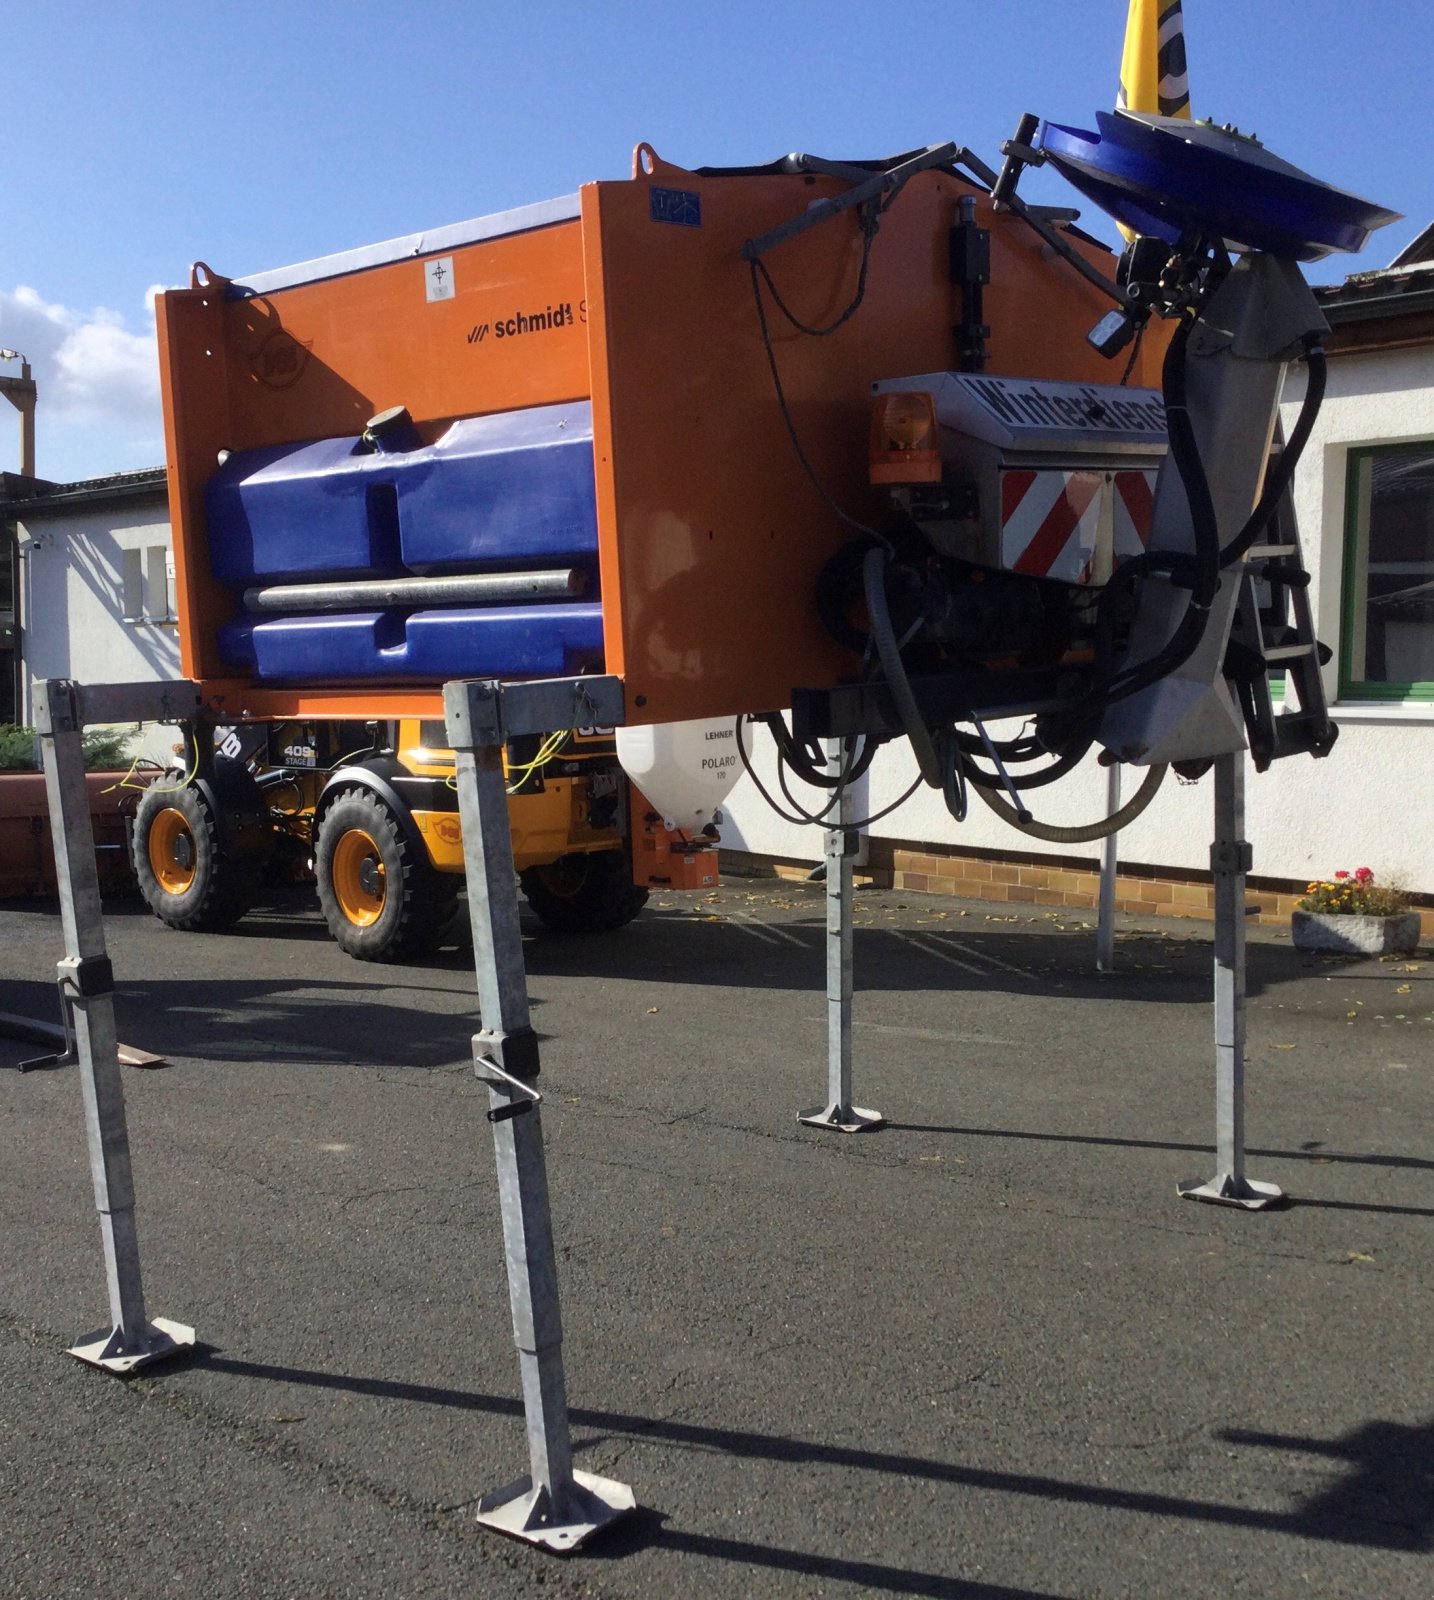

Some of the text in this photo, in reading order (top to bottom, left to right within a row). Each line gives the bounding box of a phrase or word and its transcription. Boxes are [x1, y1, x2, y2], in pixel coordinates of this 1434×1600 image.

[705, 730, 734, 740] LEHNER
[284, 745, 313, 757] 409
[285, 757, 307, 766] STAGE
[701, 755, 736, 769] POLARO
